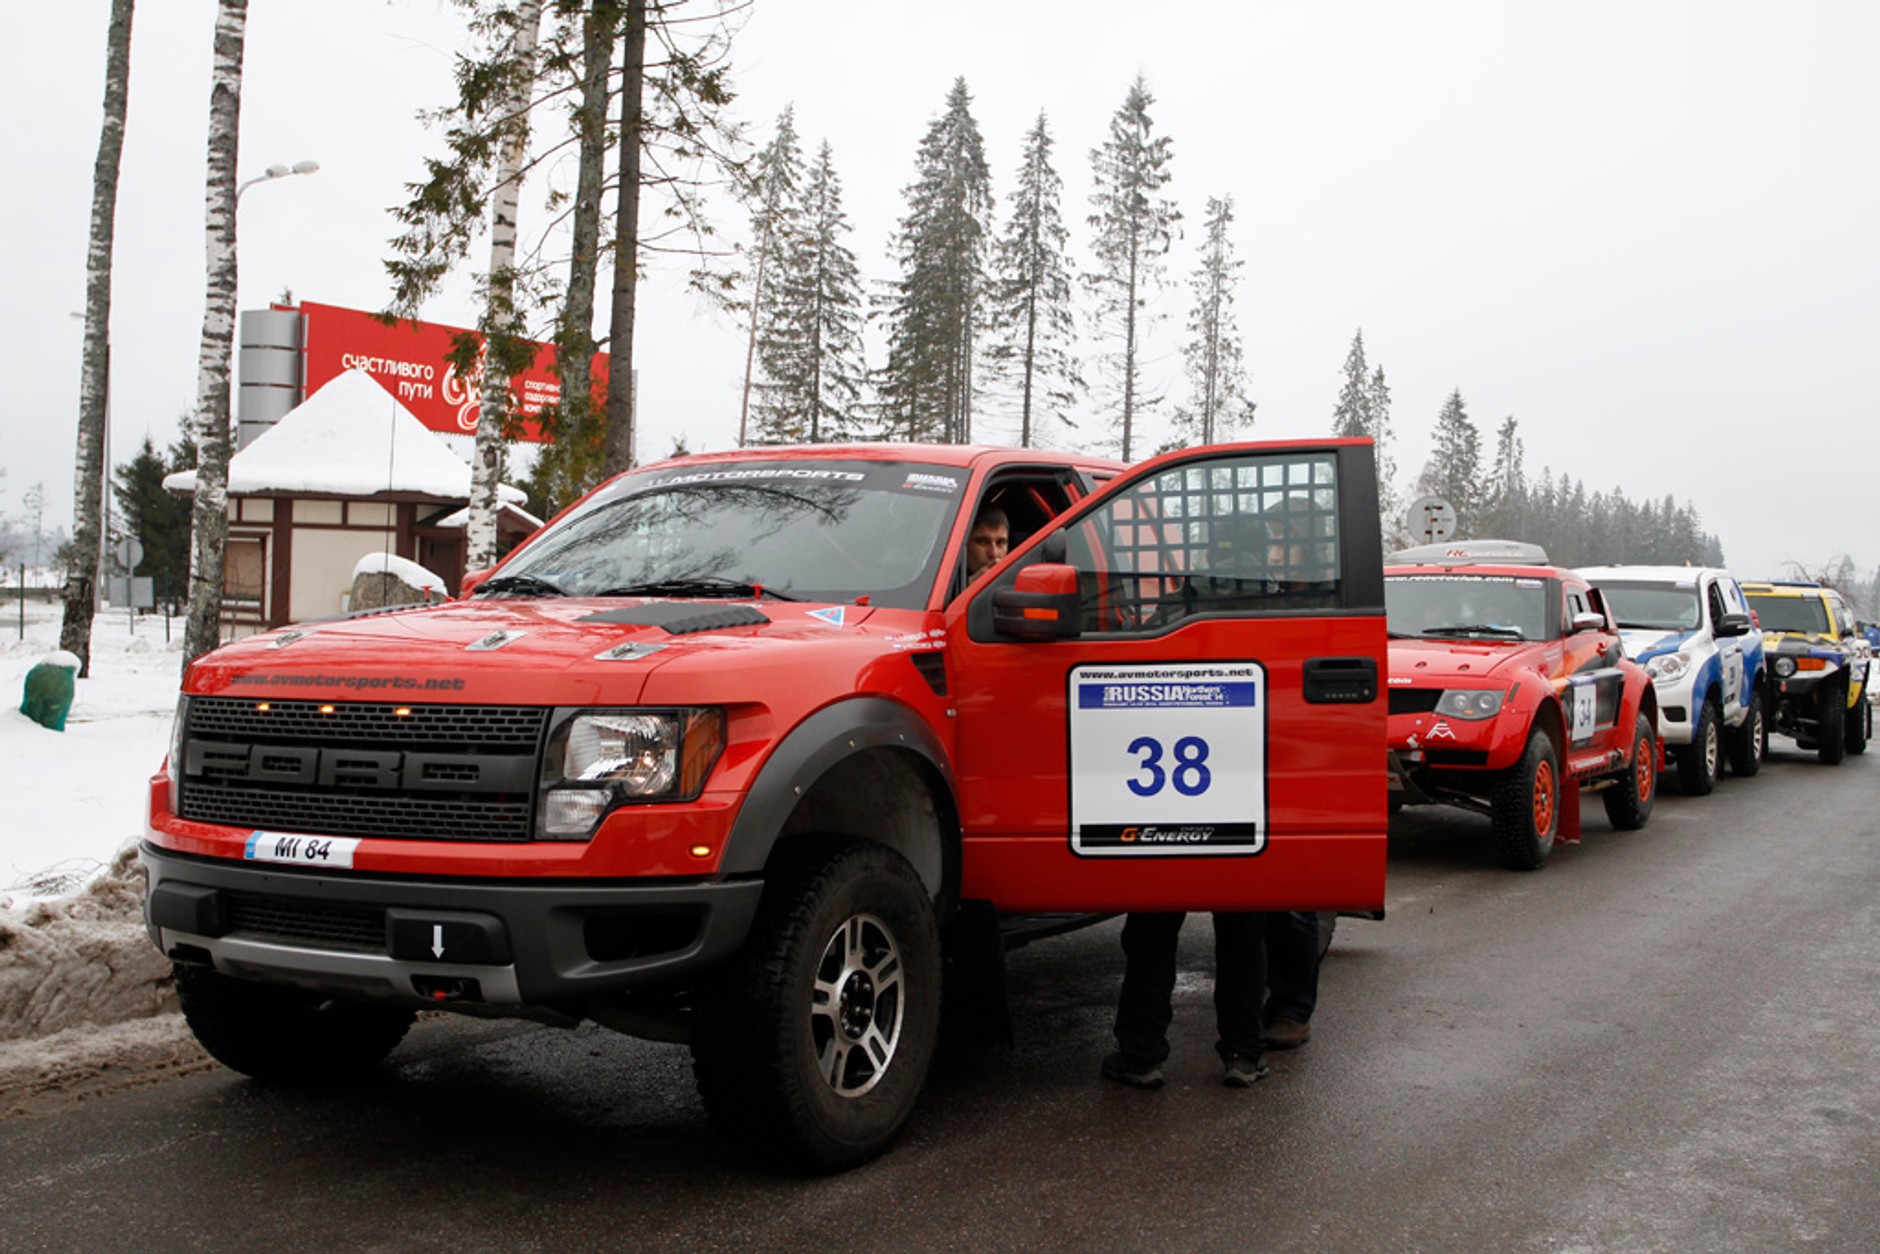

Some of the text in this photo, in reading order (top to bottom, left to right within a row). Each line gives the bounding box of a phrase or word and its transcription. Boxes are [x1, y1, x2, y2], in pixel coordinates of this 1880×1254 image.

[341, 352, 435, 381] счастливого
[398, 381, 433, 402] пути
[1079, 668, 1254, 680] www.avmotorsports.net
[1109, 685, 1184, 701] RUSSIA
[1579, 698, 1592, 727] 34
[186, 739, 535, 793] FORD
[1126, 736, 1211, 797] 38
[274, 836, 333, 861] MI 84
